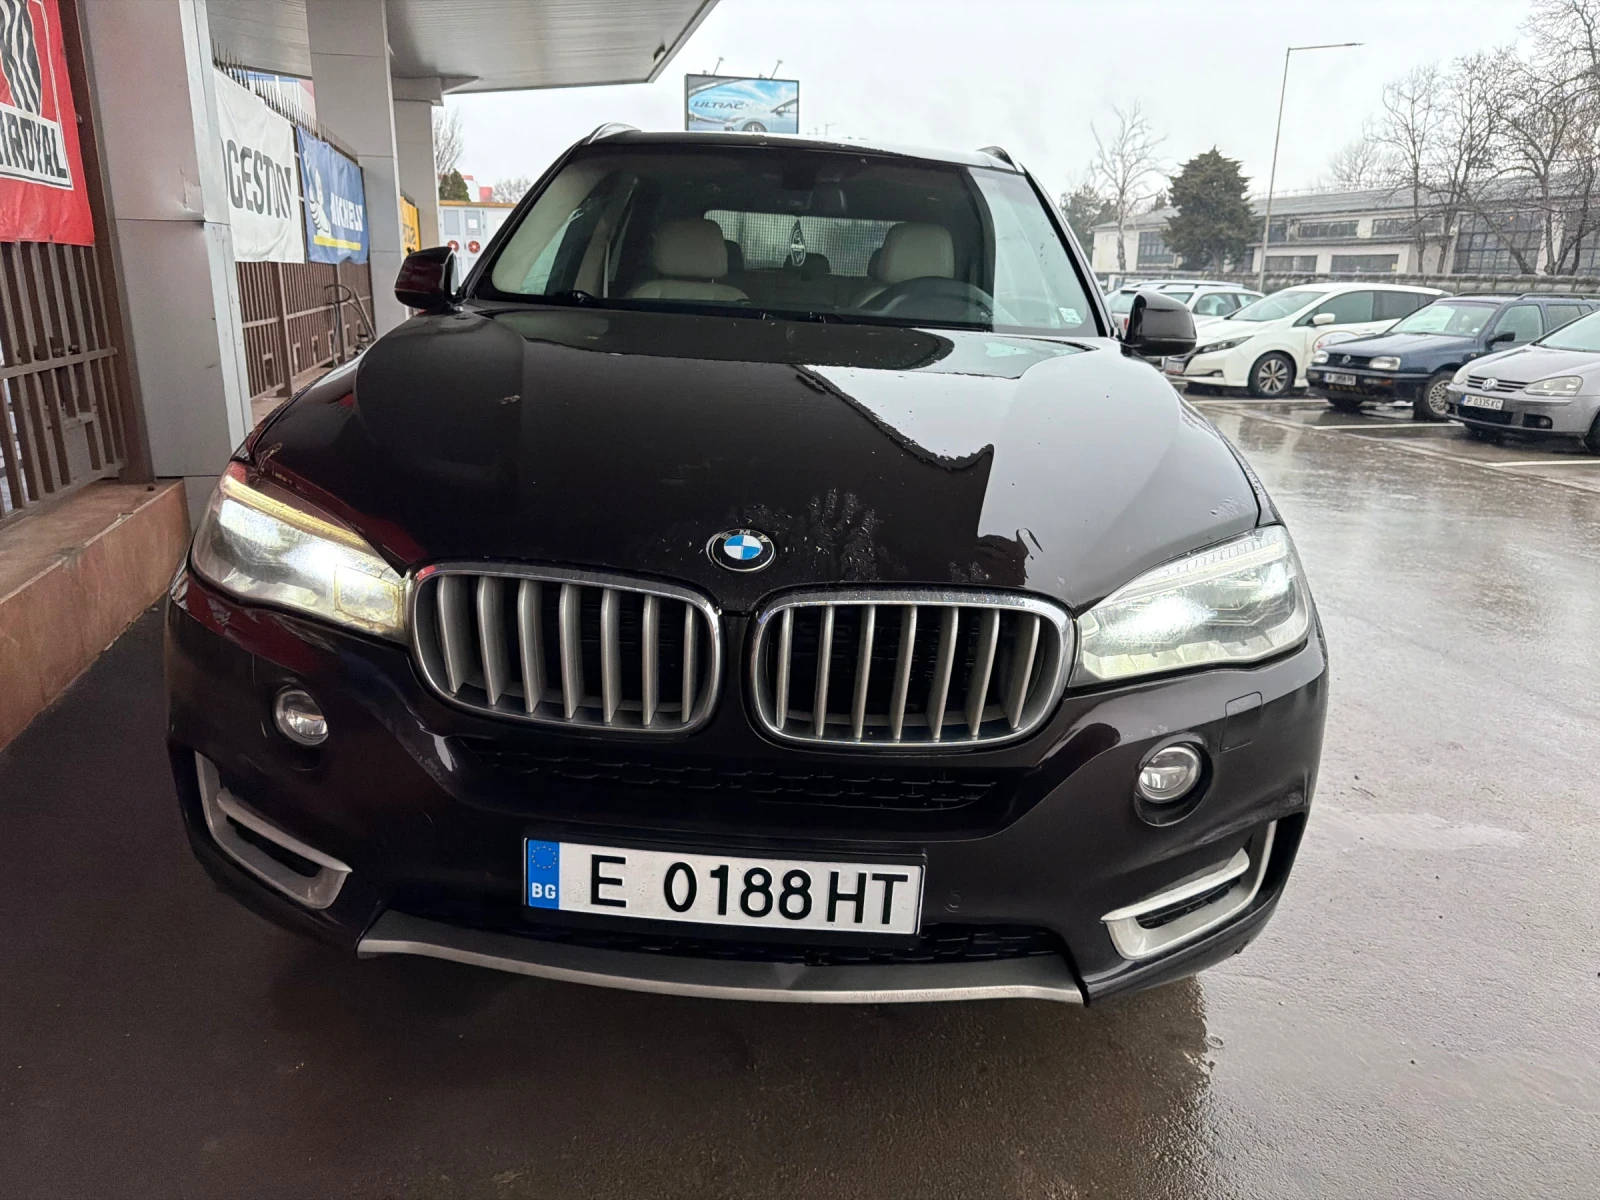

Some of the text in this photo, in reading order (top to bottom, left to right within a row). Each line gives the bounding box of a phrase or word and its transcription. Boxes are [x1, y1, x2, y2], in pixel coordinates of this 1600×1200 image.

[694, 100, 745, 110] ULTRAC
[0, 109, 68, 179] IROYAL
[531, 882, 556, 899] BG
[590, 854, 627, 908] E
